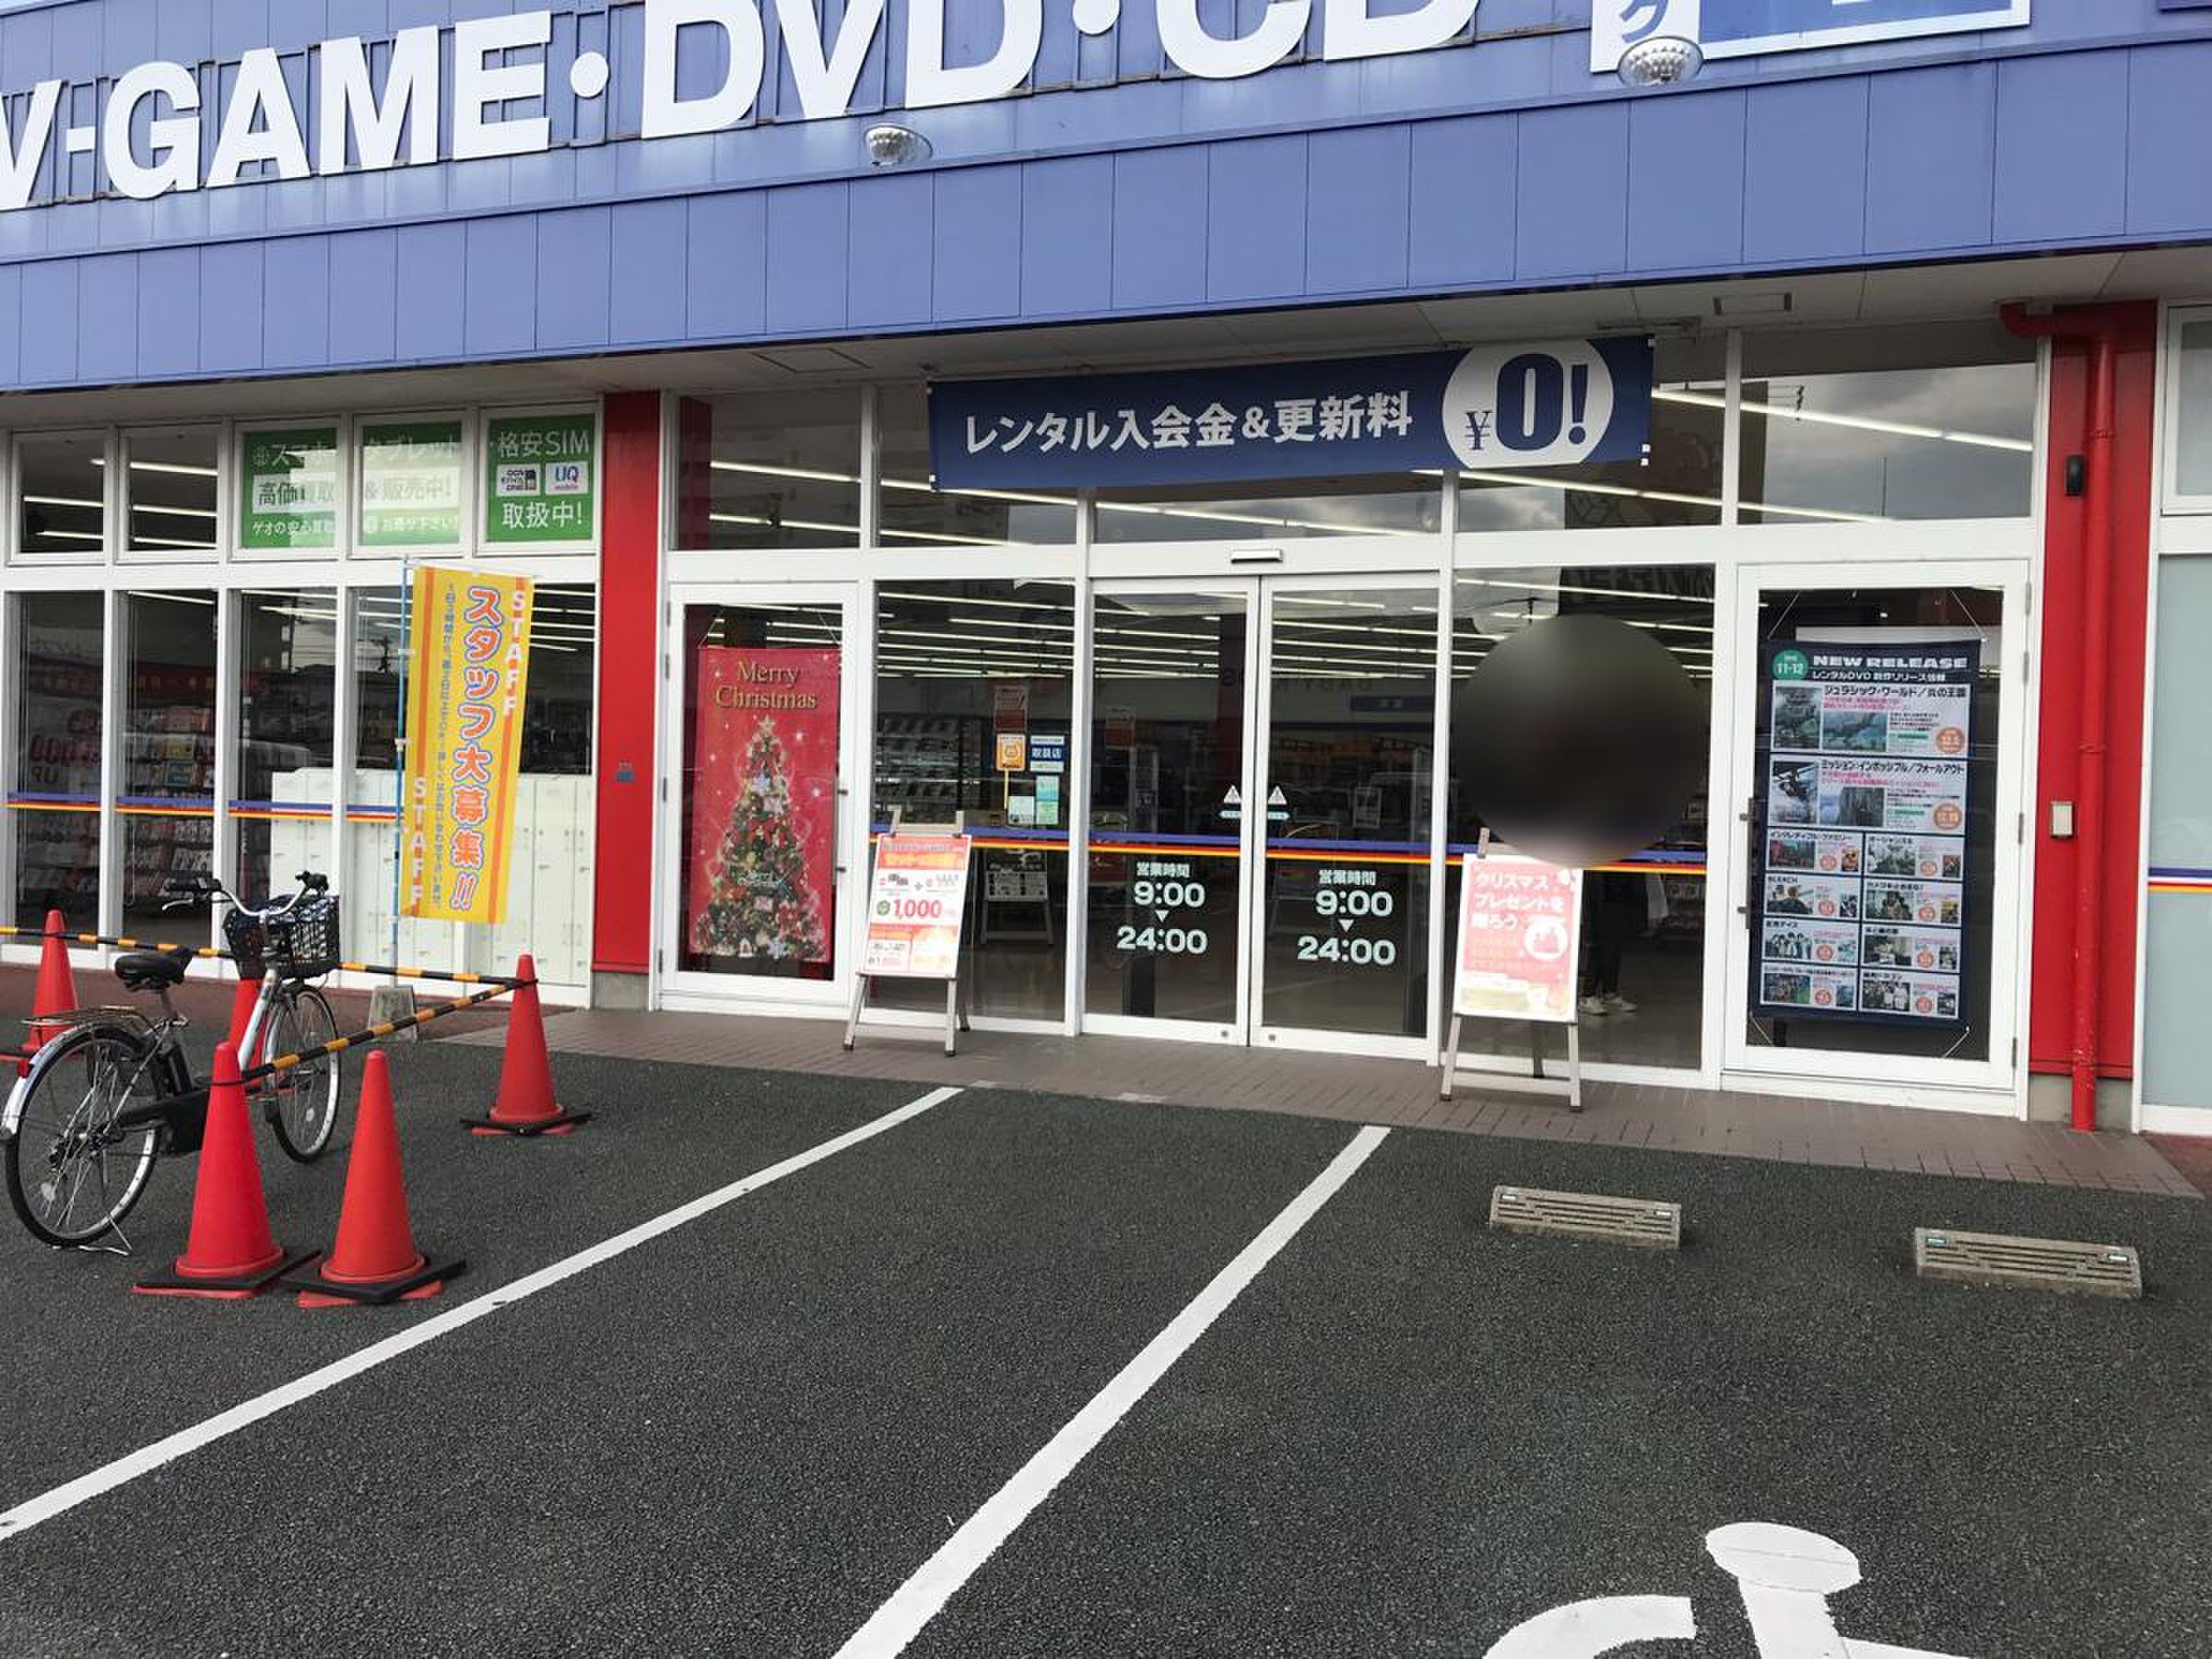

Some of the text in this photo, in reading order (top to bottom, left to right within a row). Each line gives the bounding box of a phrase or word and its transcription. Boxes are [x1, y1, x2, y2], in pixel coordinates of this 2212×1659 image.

[965, 391, 1412, 454] レンタル入会金&更新料
[499, 429, 589, 458] 格安SIM
[555, 465, 580, 483] UQ
[501, 500, 582, 529] 取扱中!
[737, 661, 799, 688] Merry
[1813, 655, 1968, 669] NEW RELEASE
[715, 685, 818, 710] Christmas
[1475, 871, 1549, 890] クリスマス
[1134, 881, 1206, 908] 9:00
[1315, 889, 1394, 916] 9:00
[1116, 926, 1208, 954] 24:00
[1297, 935, 1396, 965] 24:00
